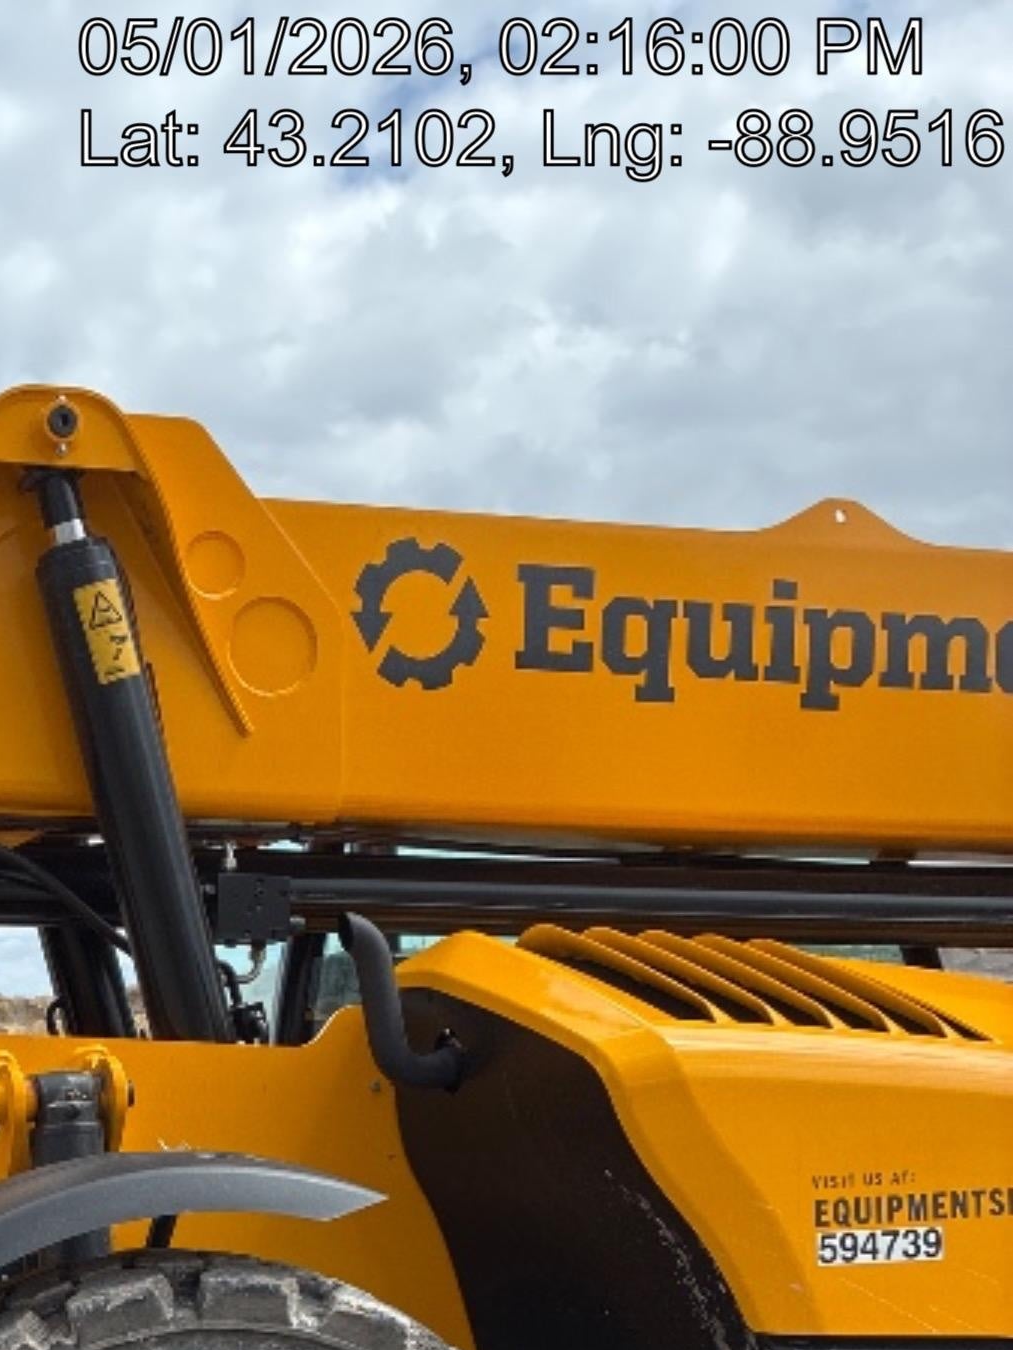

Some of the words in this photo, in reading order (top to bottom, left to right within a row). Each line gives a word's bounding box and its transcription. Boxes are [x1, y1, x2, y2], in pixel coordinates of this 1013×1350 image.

[515, 563, 1013, 710] Equipm
[863, 1172, 883, 1186] US
[819, 1228, 942, 1263] 594739
